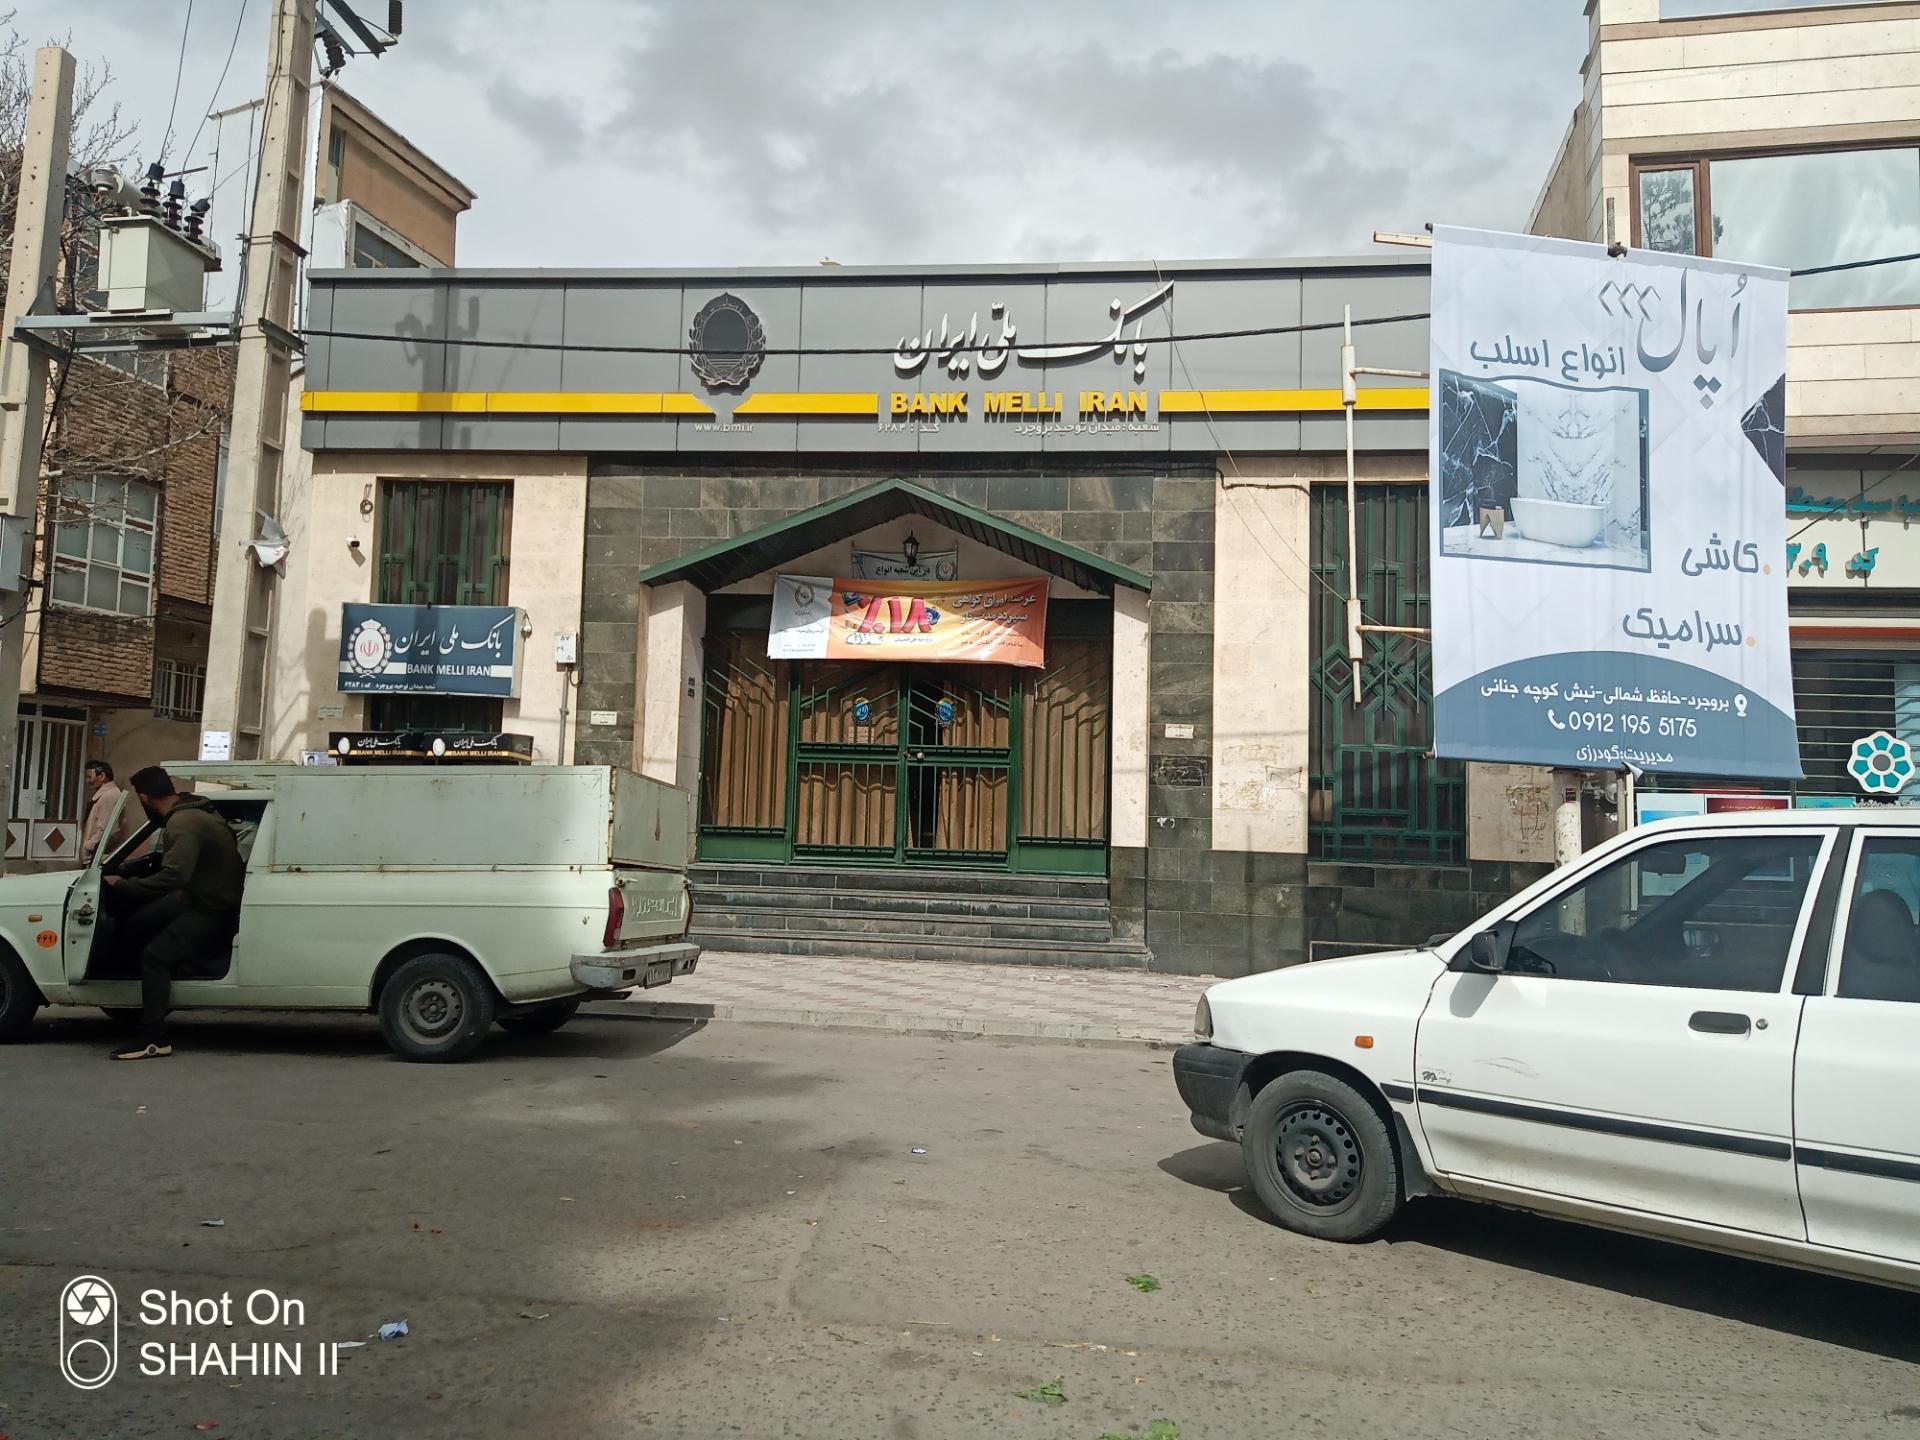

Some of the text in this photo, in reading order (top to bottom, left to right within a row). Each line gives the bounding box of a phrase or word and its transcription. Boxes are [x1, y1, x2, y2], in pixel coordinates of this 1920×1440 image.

[1017, 279, 1175, 375] بانک
[893, 312, 978, 370] ایران
[1470, 335, 1625, 383] انواع اسلب
[890, 390, 1147, 413] BANK MELLI IRAN
[1016, 421, 1052, 437] بروجرد
[1053, 421, 1087, 437] توحید
[1088, 421, 1121, 436] میدان
[1681, 533, 1759, 576] کاشی
[394, 613, 515, 658] بانک ملی ایران
[1622, 608, 1742, 652] سرامیک
[407, 663, 491, 677] BANK MELLI IRAN
[1480, 679, 1519, 698] جنانی
[1523, 682, 1559, 704] کوچه
[1568, 711, 1697, 737] 0912 195 5175
